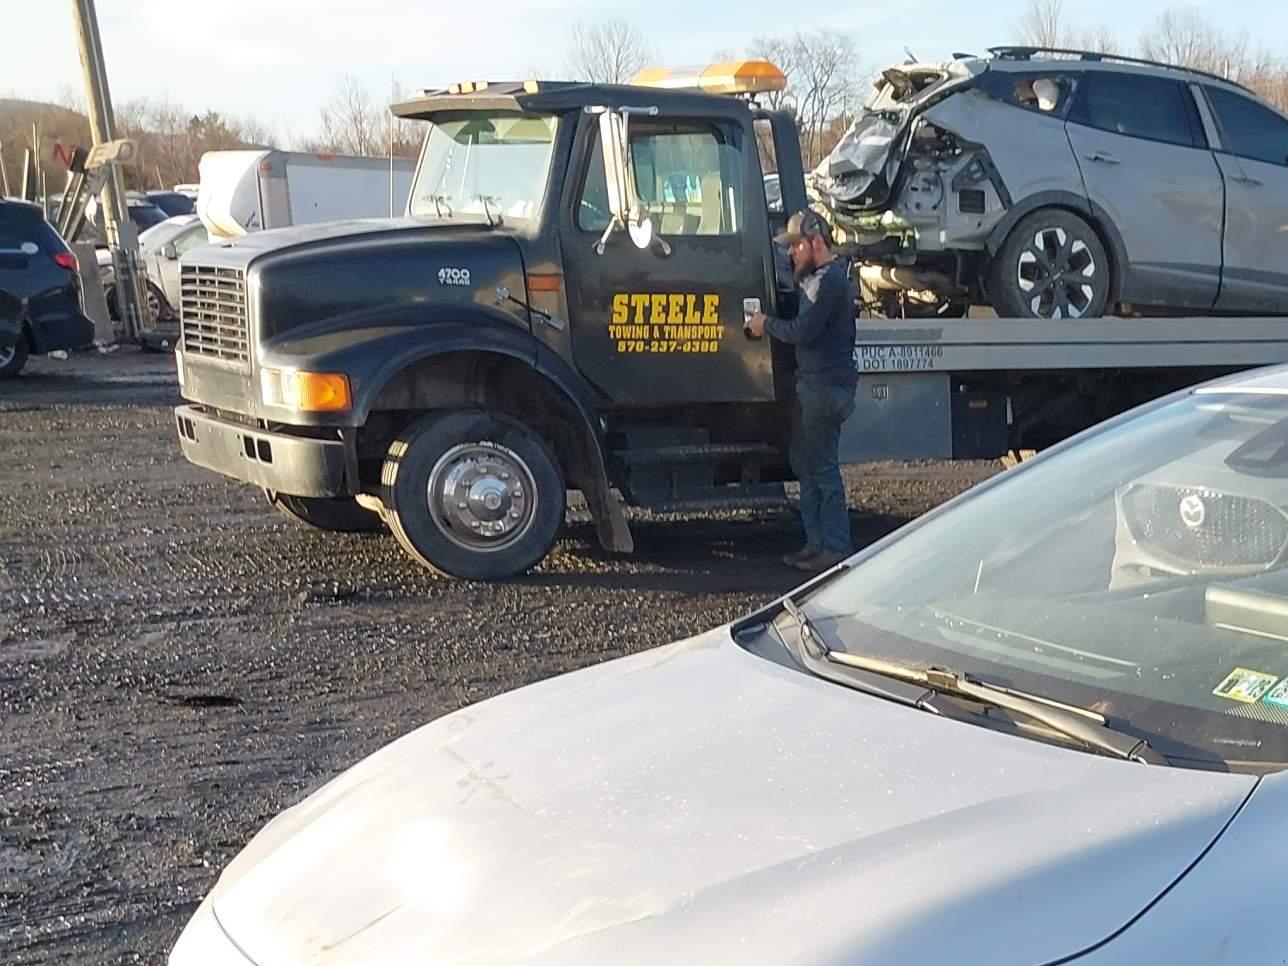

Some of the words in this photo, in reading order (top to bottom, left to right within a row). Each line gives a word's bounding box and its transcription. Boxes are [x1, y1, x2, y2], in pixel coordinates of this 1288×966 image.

[438, 267, 470, 279] 4700
[612, 293, 720, 325] STEELE
[608, 325, 650, 339] TOWING
[653, 325, 660, 339] &
[664, 325, 725, 340] TRANSPORT
[861, 346, 884, 358] PUC
[863, 359, 887, 369] DOT
